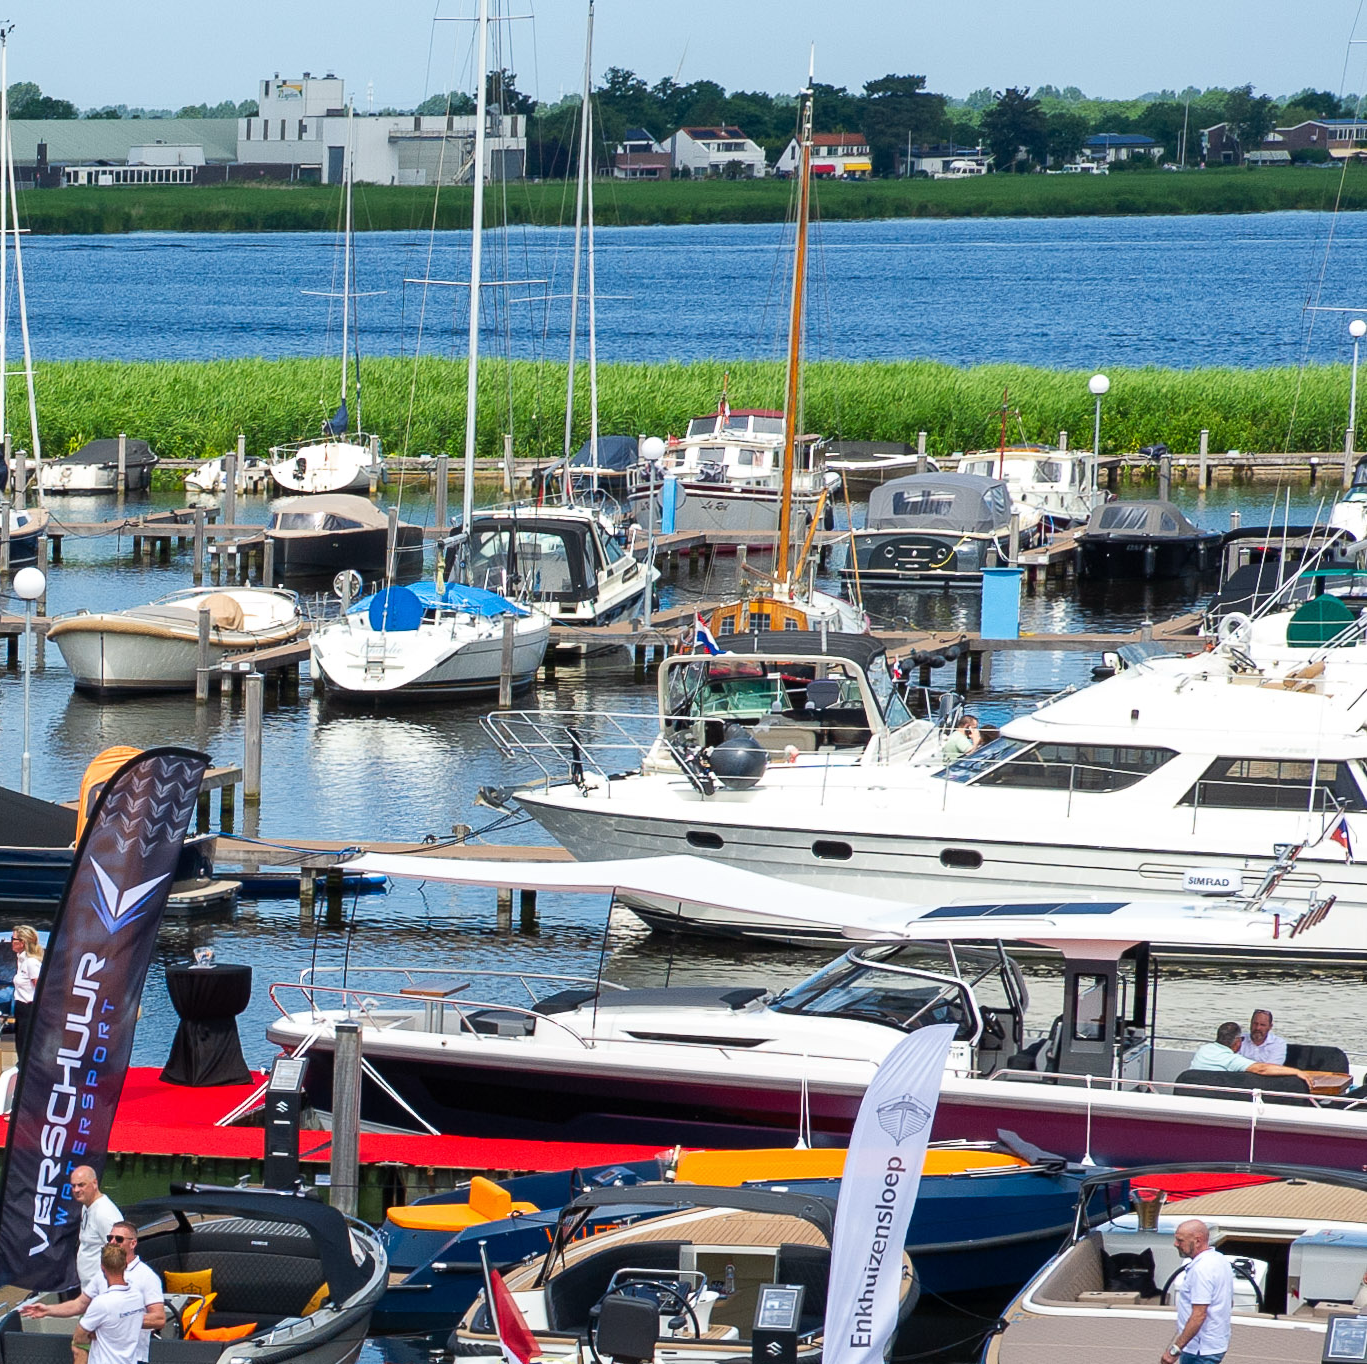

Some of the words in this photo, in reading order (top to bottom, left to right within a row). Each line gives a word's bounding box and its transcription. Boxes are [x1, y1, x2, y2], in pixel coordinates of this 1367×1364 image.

[1187, 876, 1230, 888] SIMRAD
[28, 952, 107, 1257] VERSCHUUR
[54, 999, 115, 1226] WATERSPORT
[850, 1156, 907, 1349] Enkhuizensloep
